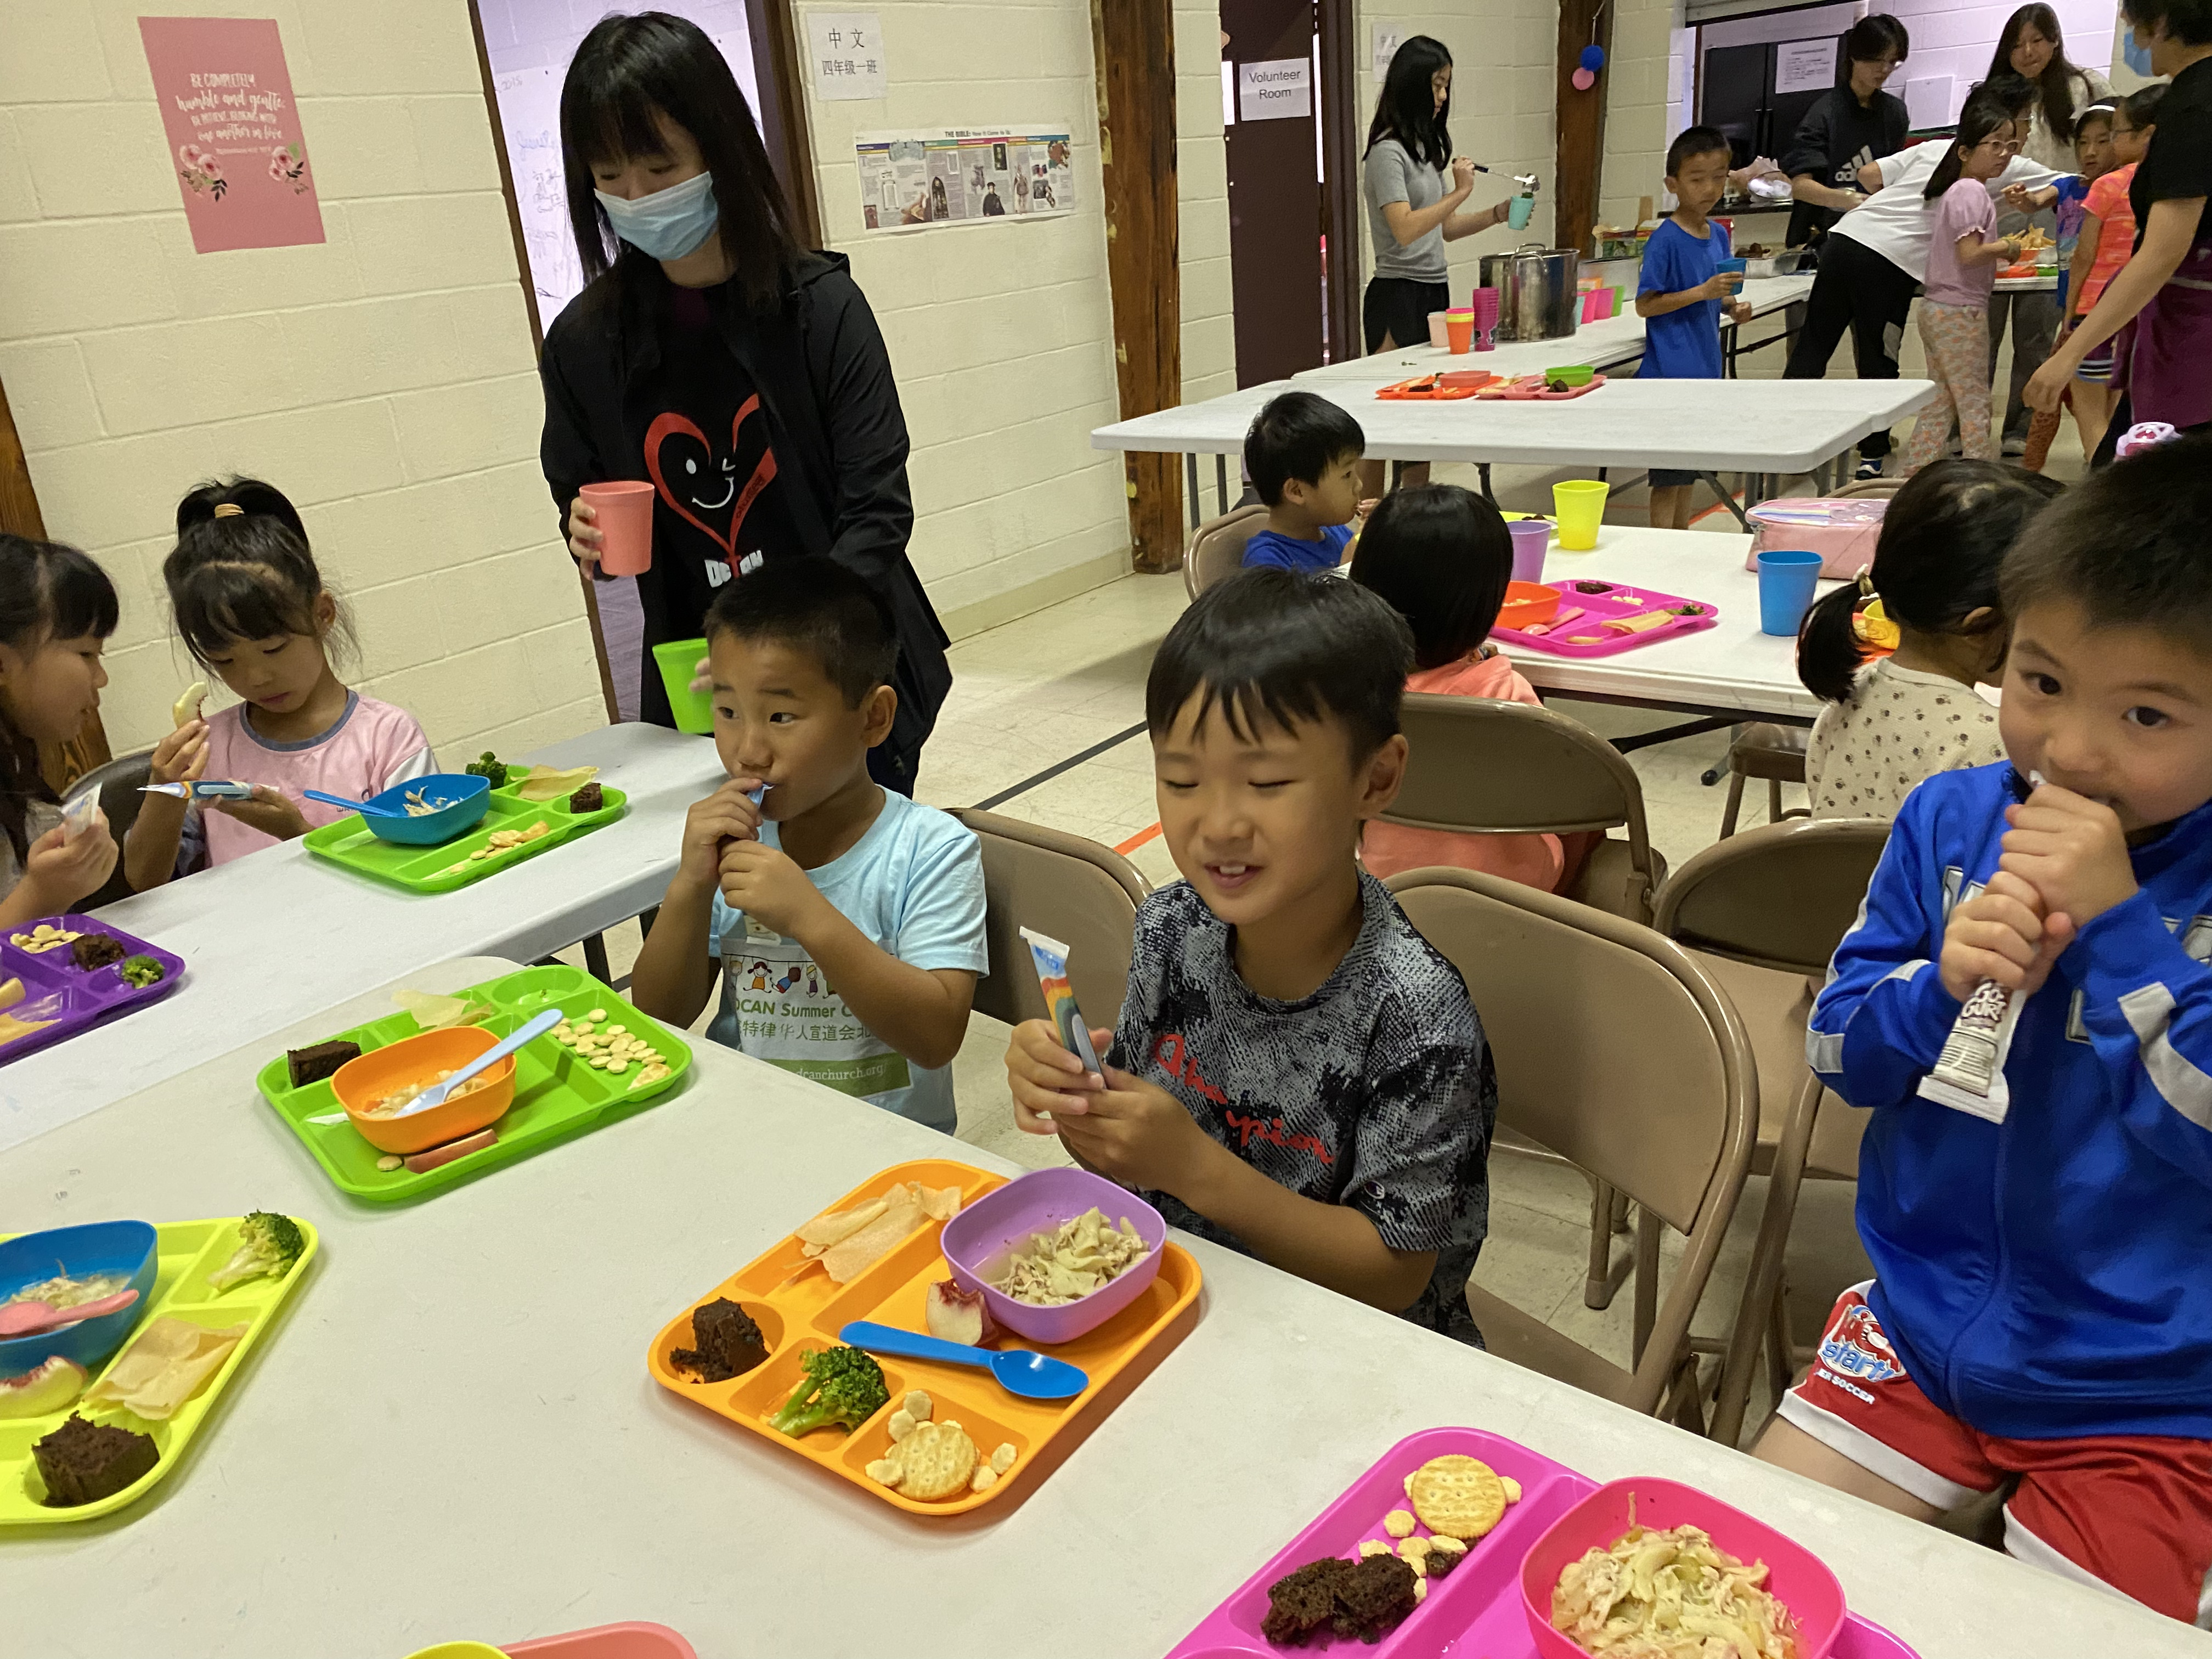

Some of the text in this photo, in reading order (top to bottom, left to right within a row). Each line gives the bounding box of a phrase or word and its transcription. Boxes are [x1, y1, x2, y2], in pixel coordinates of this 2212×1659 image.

[828, 28, 865, 49] 中文
[822, 59, 877, 75] 四年级一班
[1249, 71, 1301, 83] Volunteer
[1259, 89, 1291, 99] Room
[781, 1003, 836, 1018] Summer
[738, 1020, 871, 1041] 特律华人宣道会北
[1831, 1375, 1875, 1404] SOCCER
